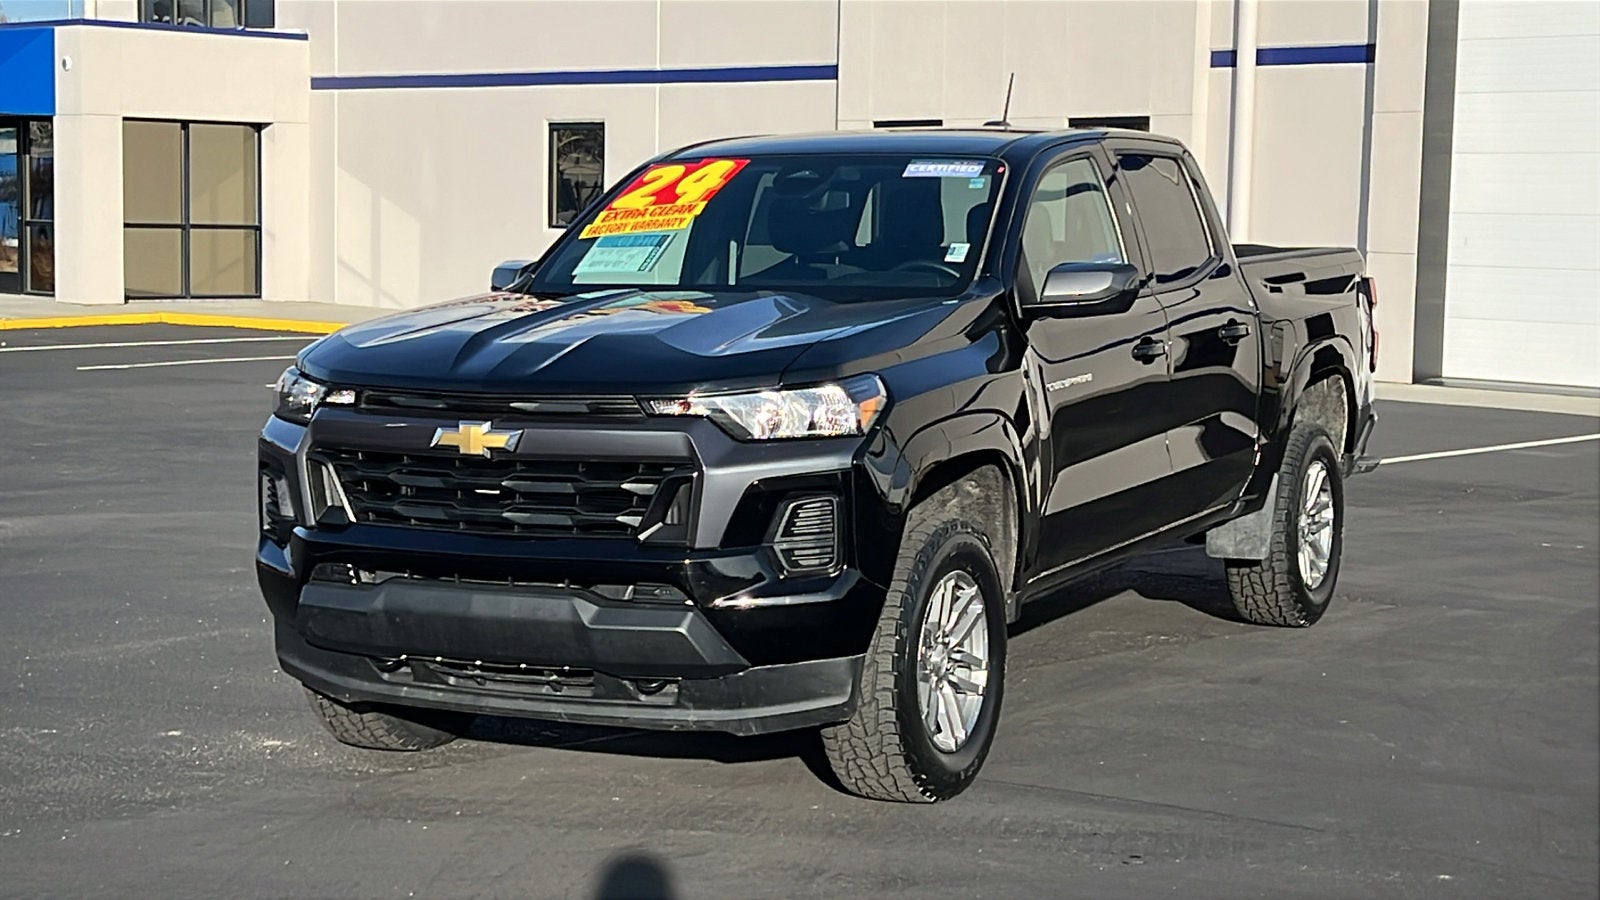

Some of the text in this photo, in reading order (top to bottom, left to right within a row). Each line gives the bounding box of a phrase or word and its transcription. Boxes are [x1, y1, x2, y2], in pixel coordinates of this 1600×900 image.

[909, 164, 979, 174] CERTIFIED
[612, 160, 736, 209] 24
[601, 203, 698, 223] EXTRA CLEAN
[586, 217, 686, 236] FACTORY WARRANTY
